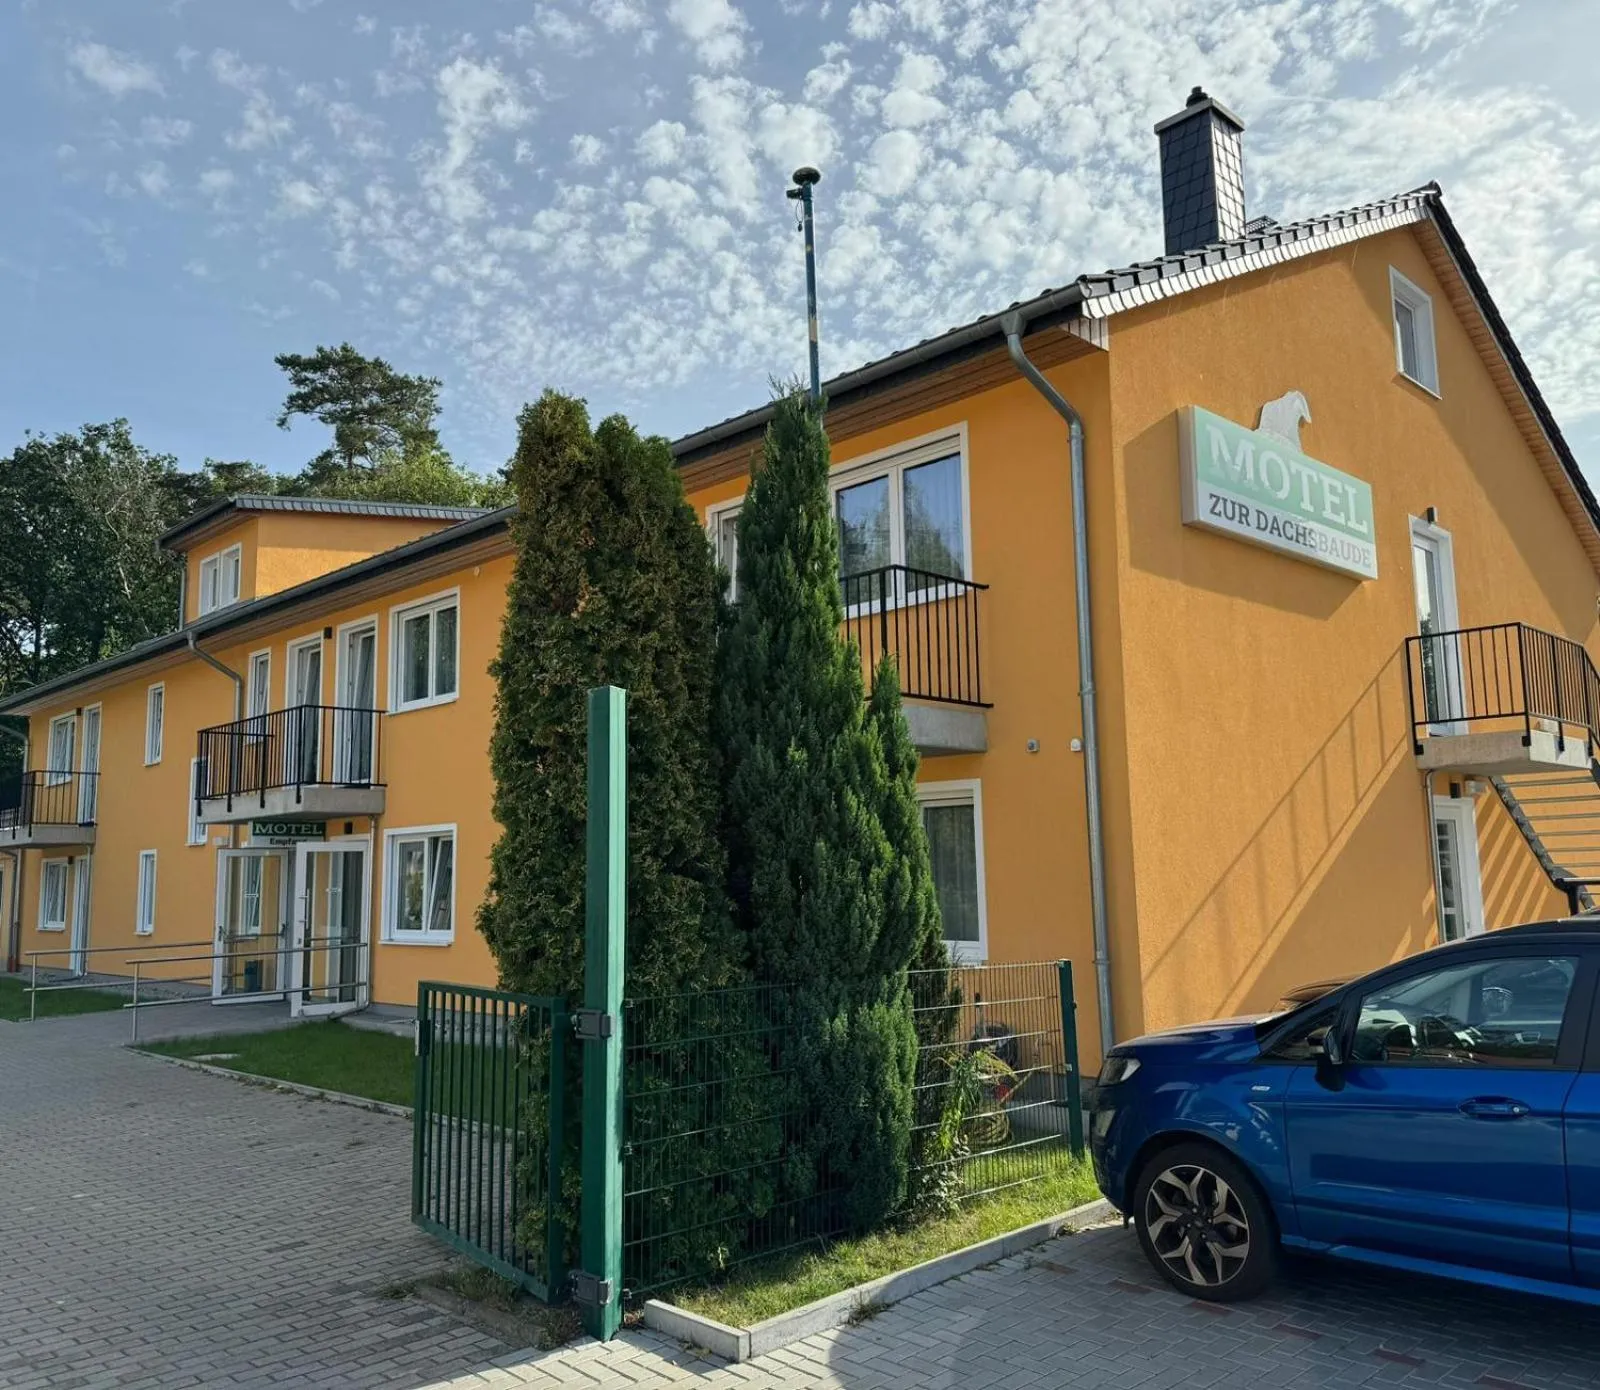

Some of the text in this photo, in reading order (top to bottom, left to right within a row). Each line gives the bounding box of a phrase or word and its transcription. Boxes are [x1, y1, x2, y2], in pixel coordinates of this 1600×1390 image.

[1206, 424, 1368, 533] MOTEL
[1209, 493, 1371, 567] ZUR DACHSBAUDE
[255, 823, 322, 834] MOTEL
